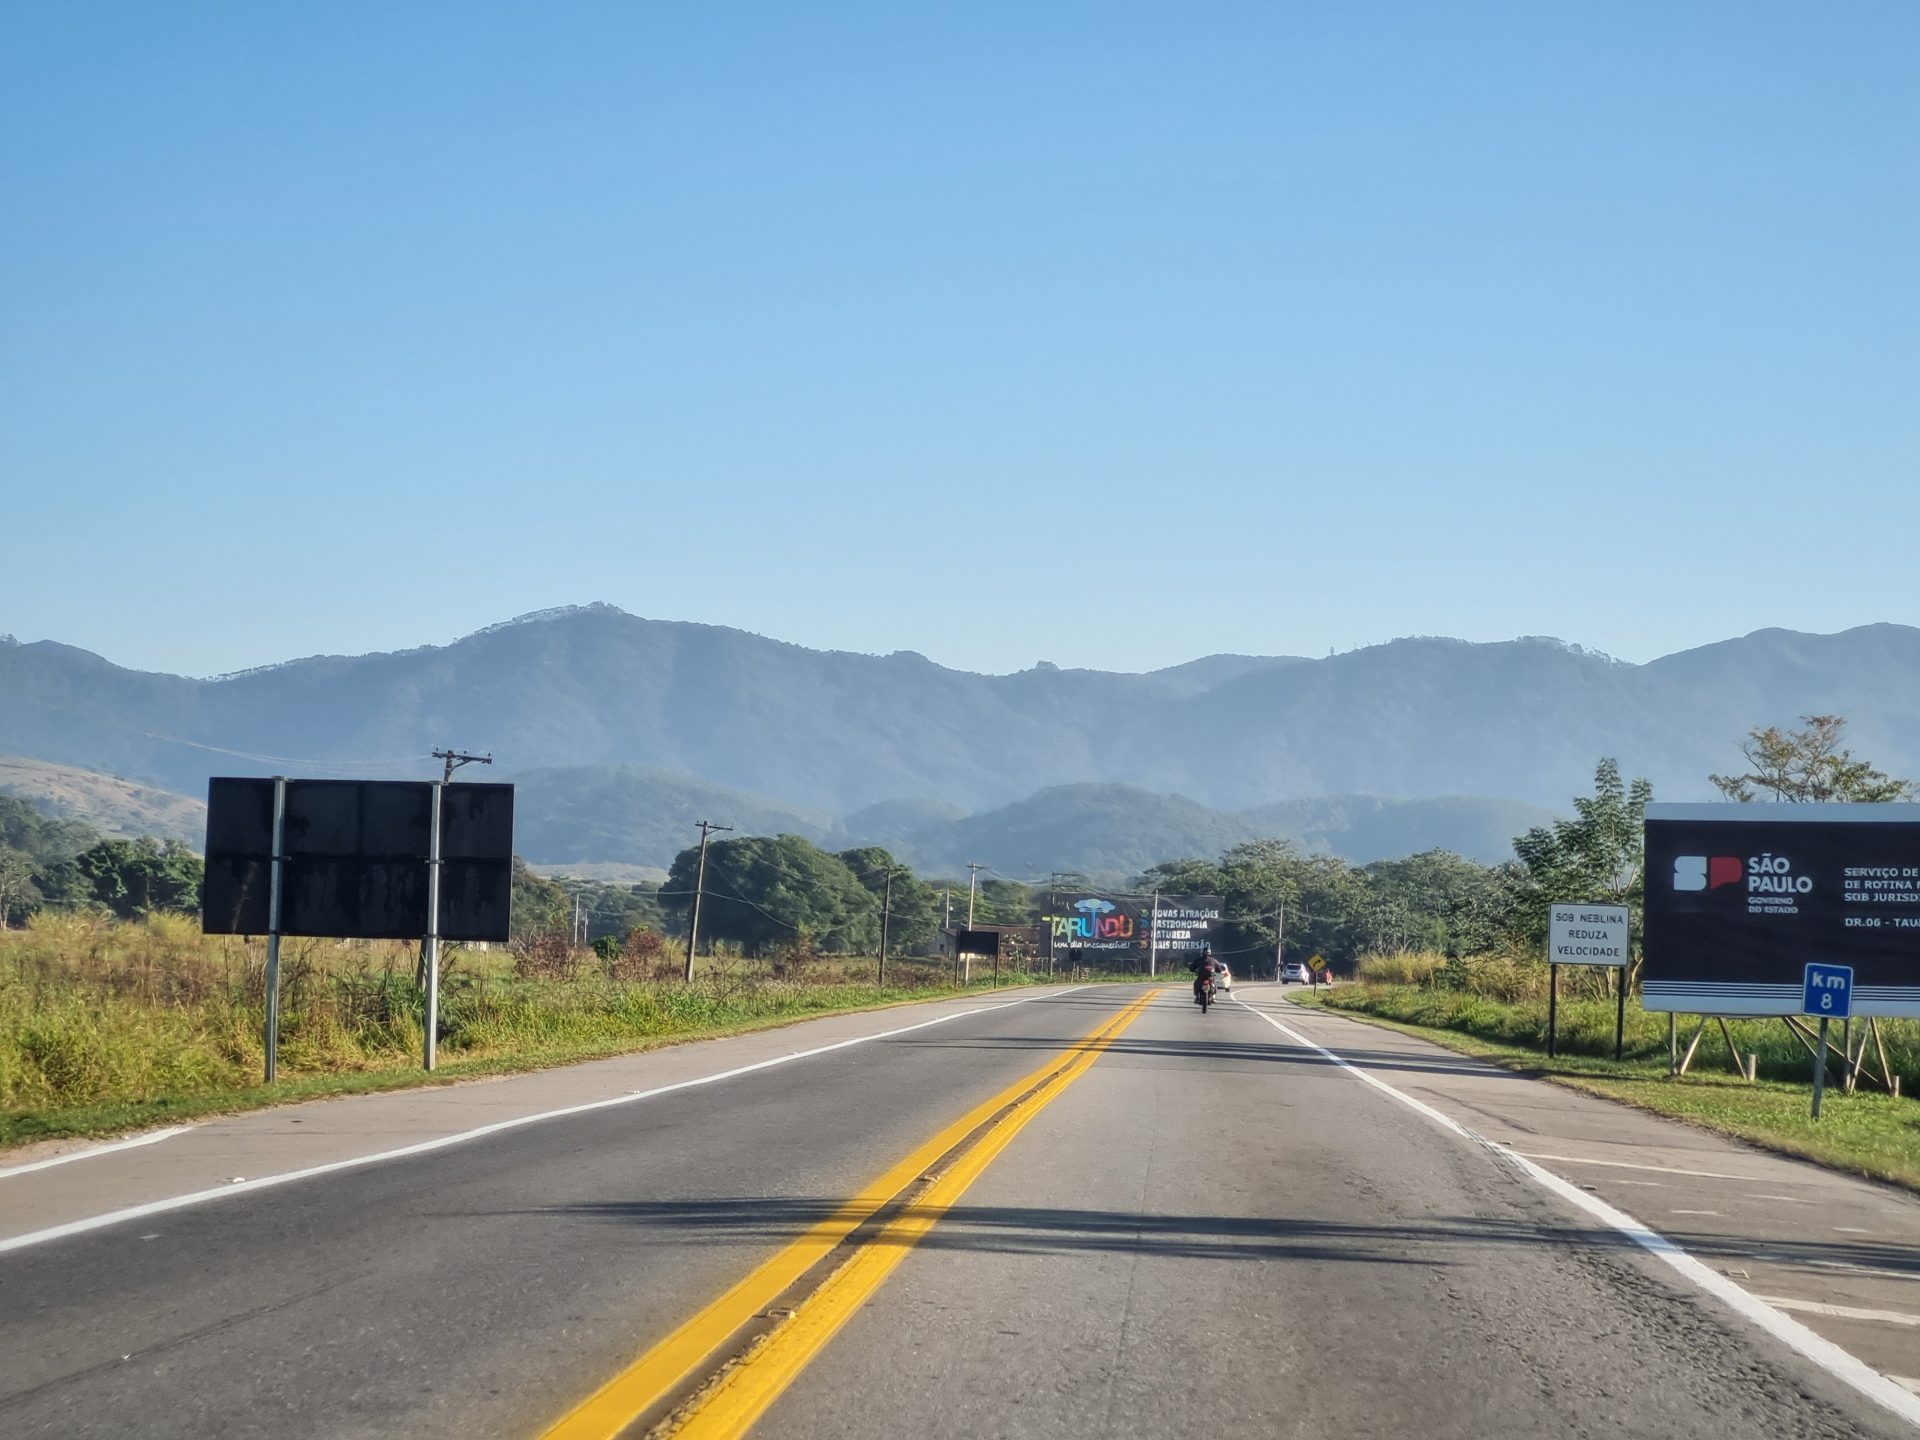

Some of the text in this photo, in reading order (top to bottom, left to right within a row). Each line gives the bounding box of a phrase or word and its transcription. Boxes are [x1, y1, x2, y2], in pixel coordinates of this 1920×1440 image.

[1748, 853, 1790, 874] SÃO
[1844, 867, 1919, 878] SERVIÇO DE
[1748, 876, 1813, 893] PAULO
[1844, 880, 1861, 889] DE
[1864, 880, 1913, 889] ROTINA
[1748, 896, 1793, 905] GOVERNO
[1844, 892, 1869, 902] SOB
[1748, 906, 1798, 914] DO ESTADO
[1555, 912, 1624, 924] SOB NEBLINA
[1845, 918, 1881, 927] DR.06
[1568, 929, 1608, 940] REDUZA
[1557, 946, 1620, 957] VELOCIDADE
[1812, 971, 1845, 990] km
[1820, 993, 1832, 1010] 8
